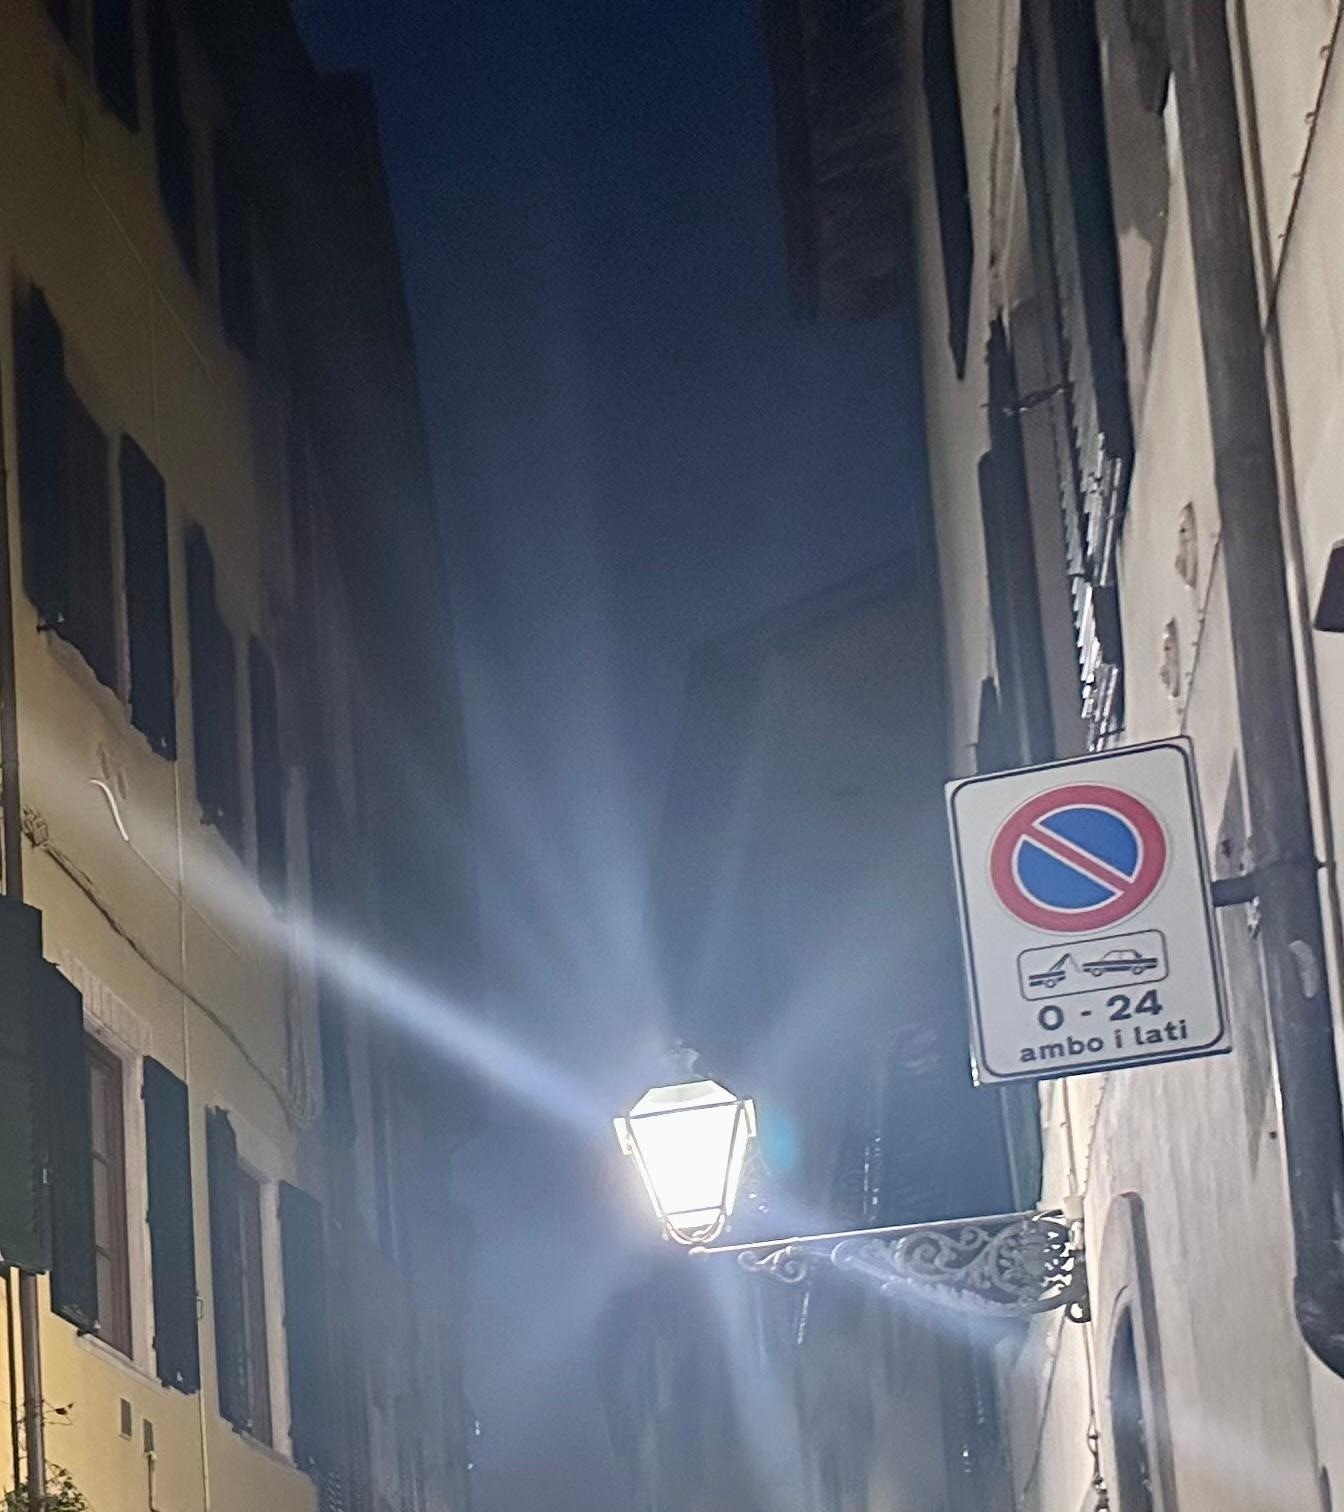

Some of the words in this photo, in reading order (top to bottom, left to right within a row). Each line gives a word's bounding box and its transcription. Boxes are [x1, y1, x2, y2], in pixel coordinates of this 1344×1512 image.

[1106, 989, 1163, 1022] 24
[1020, 1036, 1105, 1063] ambo
[1115, 1029, 1123, 1049] i
[1133, 1019, 1189, 1046] lati
